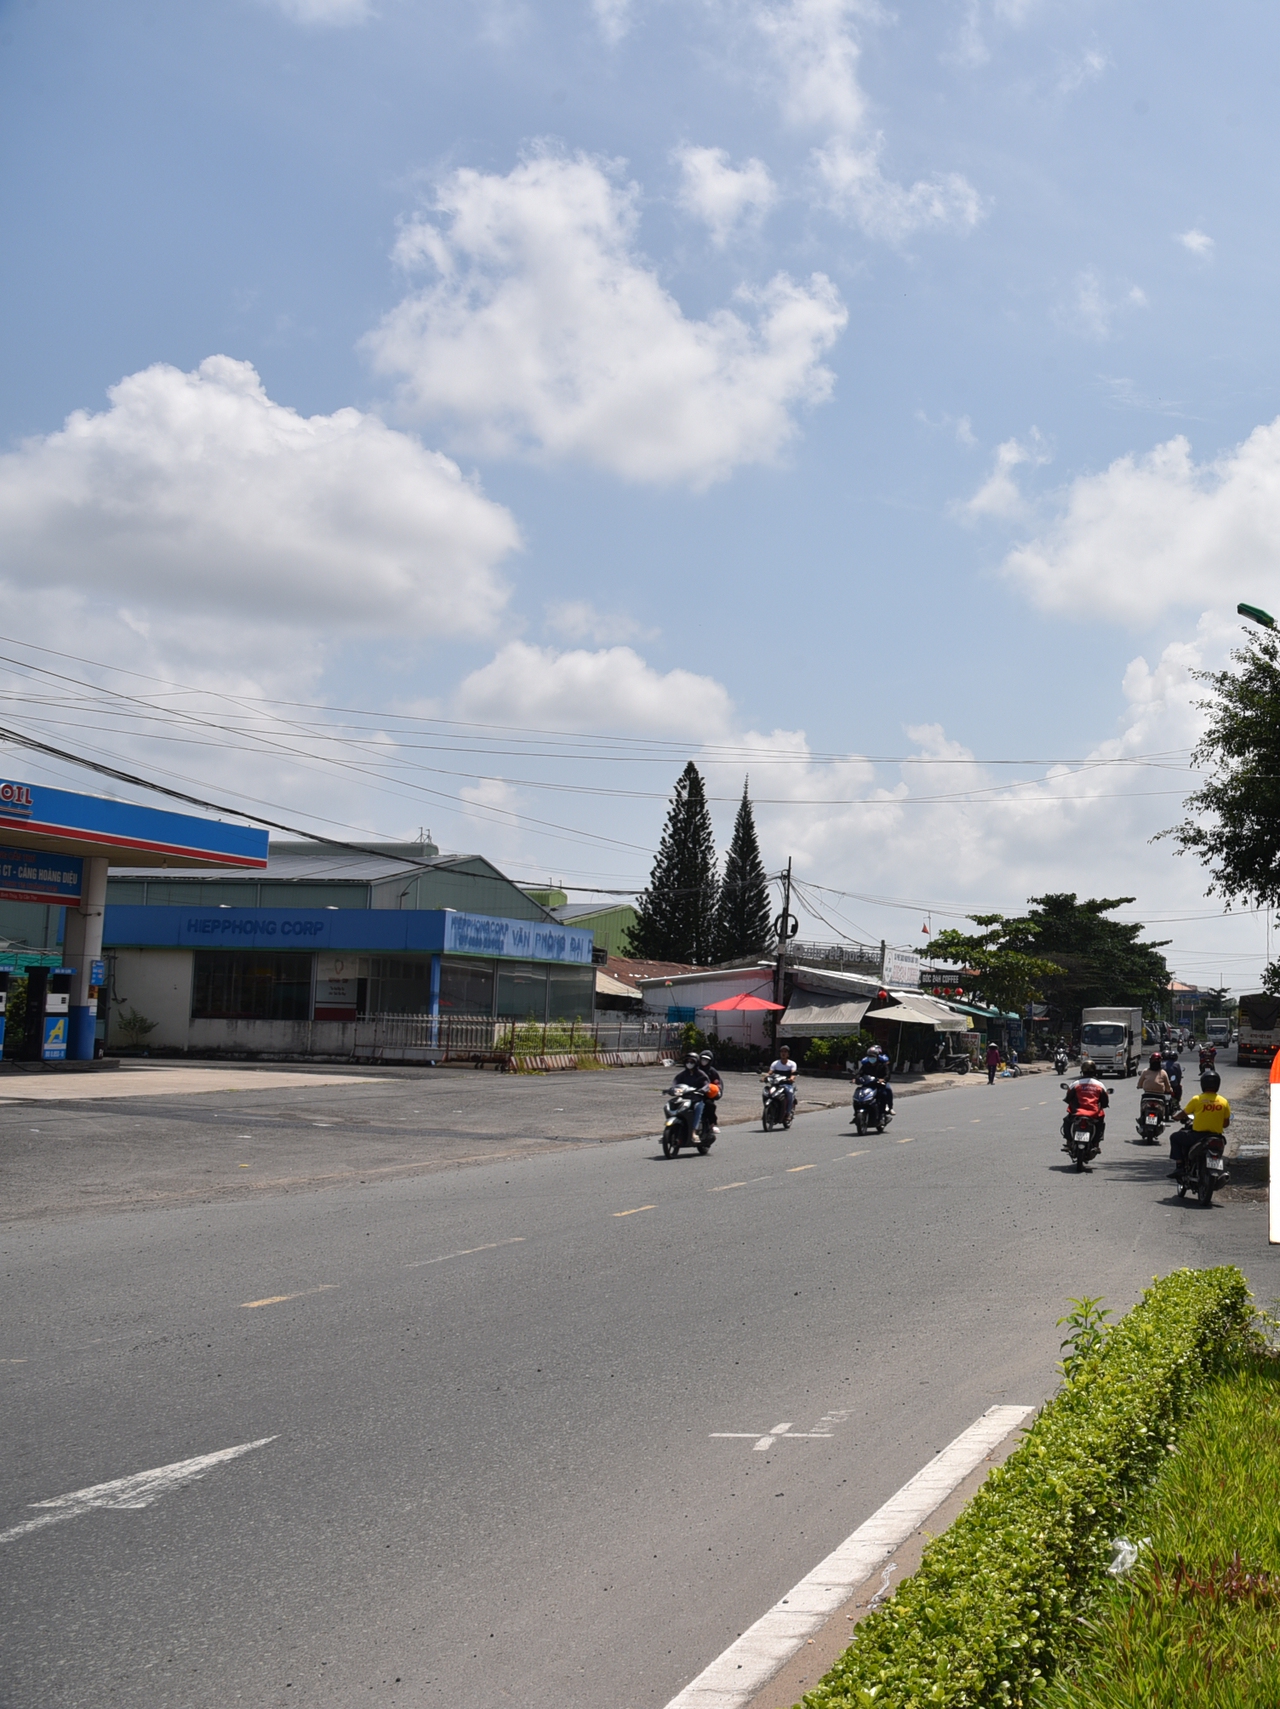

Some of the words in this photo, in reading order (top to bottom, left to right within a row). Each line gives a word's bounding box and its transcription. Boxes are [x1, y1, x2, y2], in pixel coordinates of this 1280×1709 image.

[2, 864, 12, 877] CT
[18, 863, 37, 879] CẢNG
[38, 868, 61, 882] HOÀNG
[62, 870, 78, 886] DIỆU
[187, 918, 277, 935] HIEPPHONG
[280, 920, 324, 935] CORP
[942, 974, 959, 984] COFFEE
